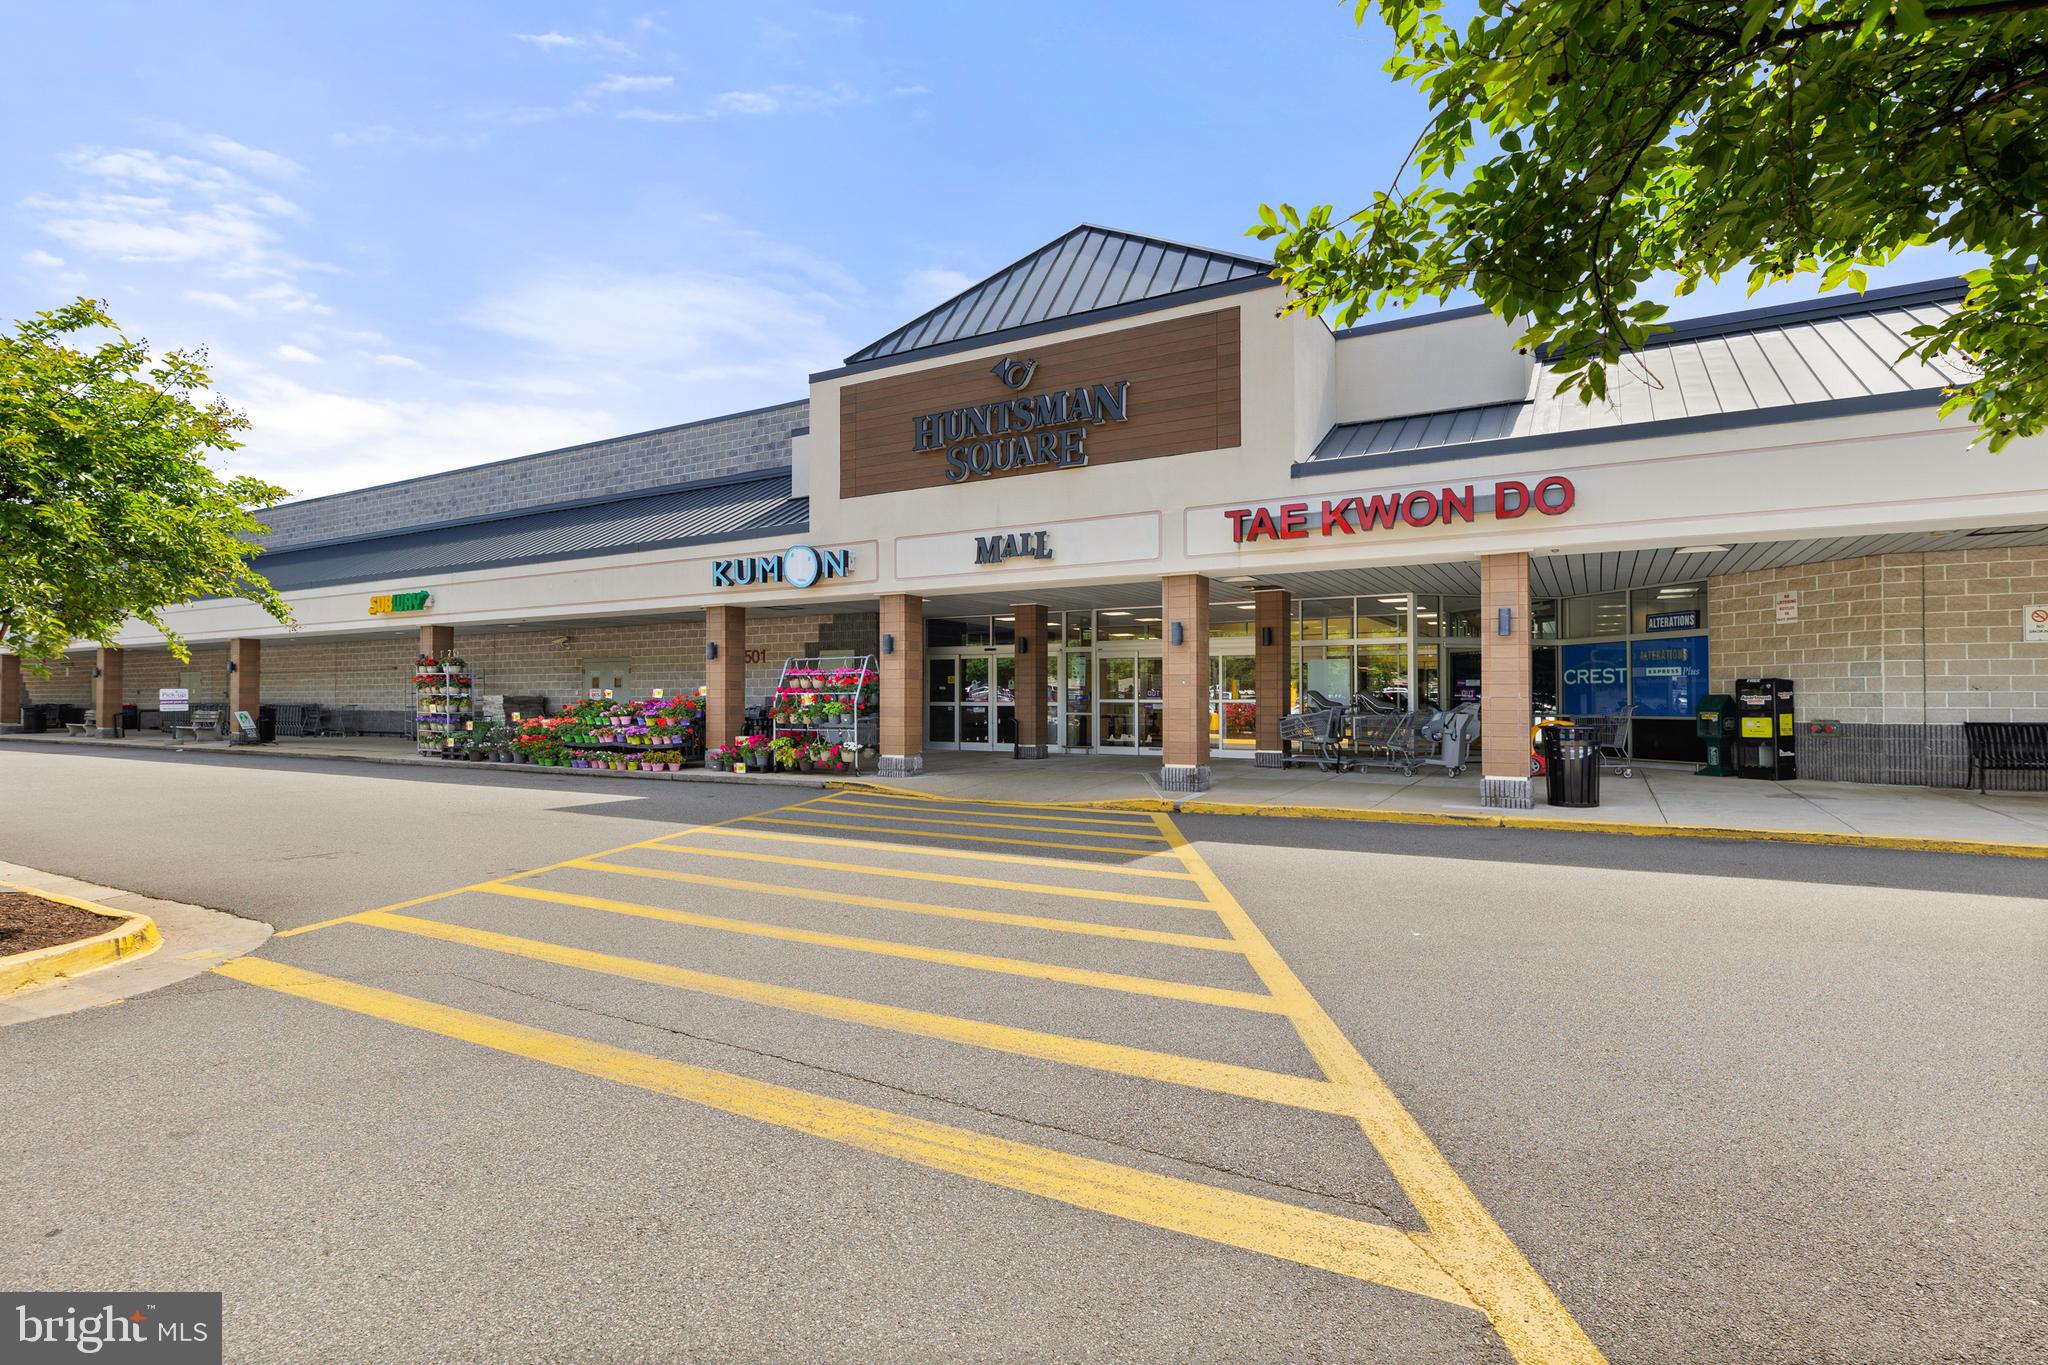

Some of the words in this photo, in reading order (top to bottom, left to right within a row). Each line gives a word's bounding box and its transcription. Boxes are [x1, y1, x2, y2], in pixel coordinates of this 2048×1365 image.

[912, 380, 1130, 452] HUNTSMAN
[945, 426, 1089, 482] SQUARE
[1225, 503, 1309, 543] TAE
[1321, 485, 1474, 536] KWON
[1495, 476, 1576, 520] DO
[974, 530, 1053, 565] MALL
[712, 544, 849, 589] KUMON
[368, 589, 430, 615] SUBWAY
[1648, 614, 1695, 630] ALTERATIONS
[1563, 667, 1628, 685] CREST
[1682, 666, 1700, 676] Plus
